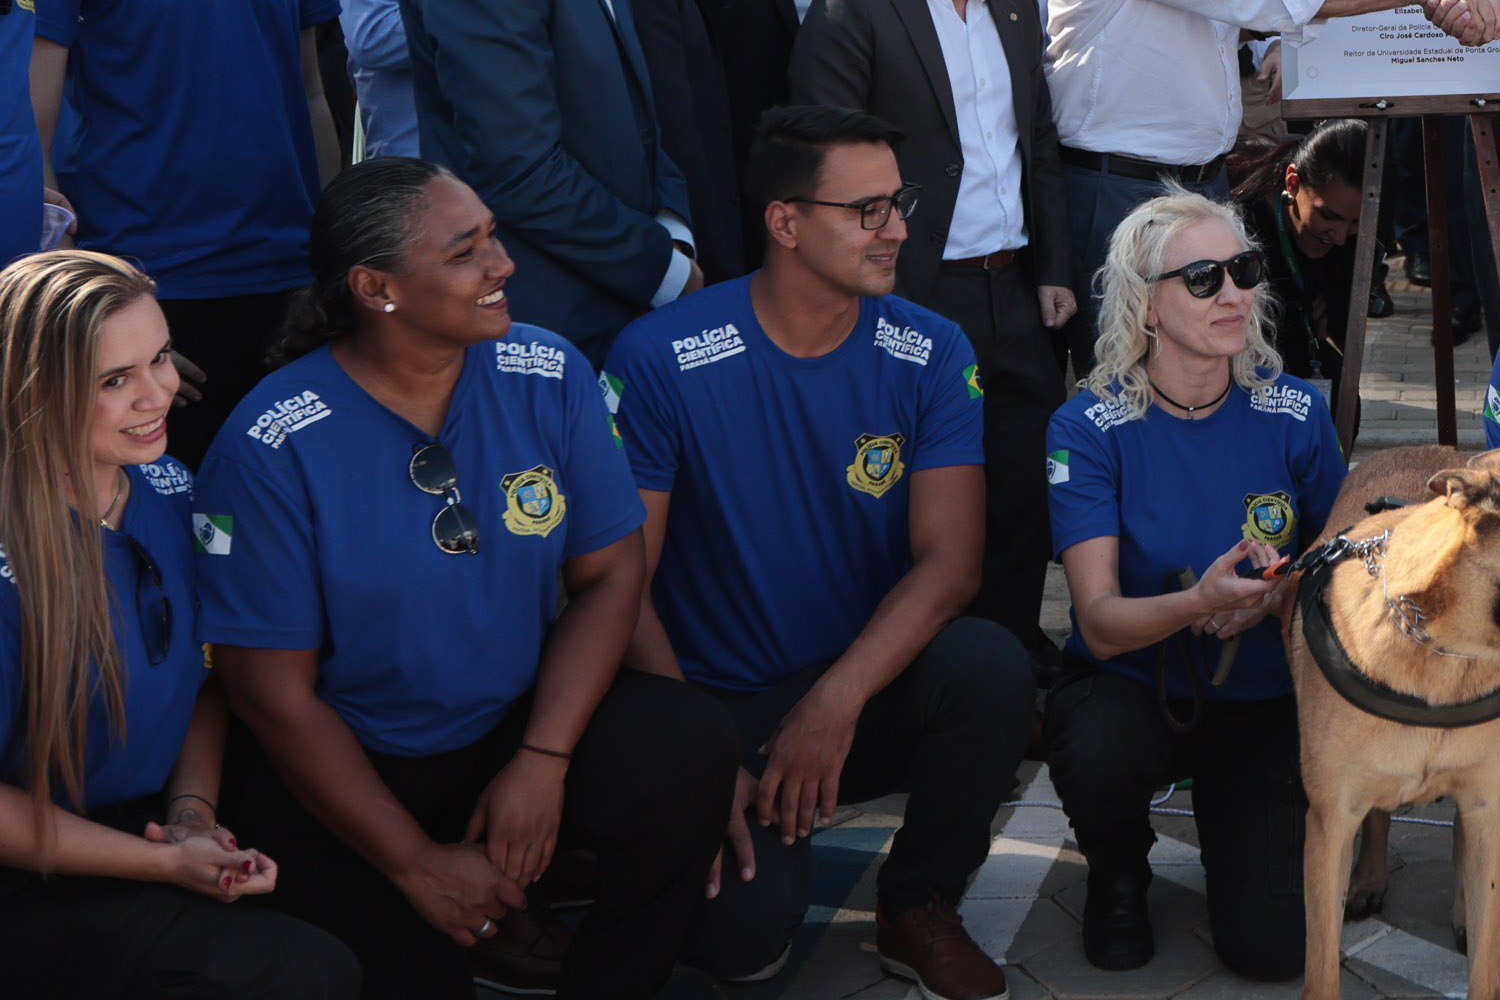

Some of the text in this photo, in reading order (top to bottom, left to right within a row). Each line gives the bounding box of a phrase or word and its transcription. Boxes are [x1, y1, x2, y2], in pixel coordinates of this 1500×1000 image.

[1394, 7, 1425, 15] Elizabet
[1414, 31, 1444, 39] Cardoso
[1377, 48, 1422, 56] Universidade
[1423, 47, 1454, 55] Estadual
[1465, 46, 1486, 54] Ponta
[1391, 57, 1415, 65] Miguel
[672, 323, 740, 354] POLÍCIA
[877, 317, 933, 350] POLÍCIA
[496, 341, 566, 364] POLÍCIA
[677, 335, 744, 364] CIENTÍFICA
[496, 354, 564, 374] CIENTÍFICA
[247, 390, 320, 440] POLÍCIA
